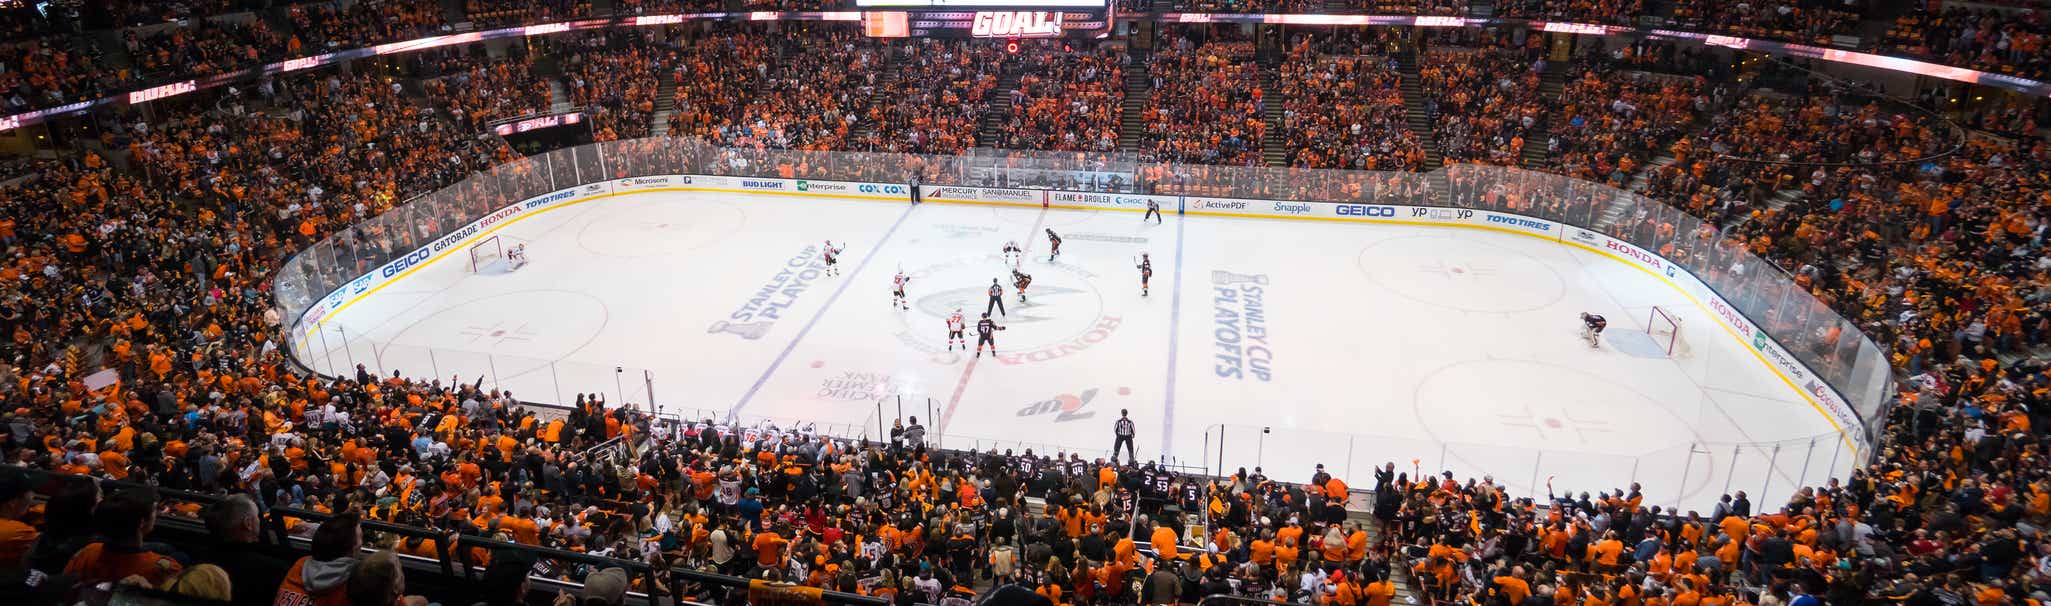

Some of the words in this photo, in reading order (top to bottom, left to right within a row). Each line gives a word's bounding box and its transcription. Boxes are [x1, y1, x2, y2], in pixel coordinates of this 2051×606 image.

[970, 11, 1064, 38] GOAL!
[743, 180, 760, 188] BUD
[760, 181, 783, 190] LIGHT
[942, 187, 977, 195] MERCURY
[525, 197, 549, 210] TOYO
[549, 190, 575, 203] TIRES
[1055, 193, 1077, 202] FLAME
[1206, 201, 1246, 210] ActivePDF
[1274, 202, 1311, 214] Snapple
[1336, 204, 1396, 218] GEICO
[1412, 207, 1428, 217] yp
[1457, 209, 1473, 219] yp
[480, 205, 522, 229] HONDA
[1487, 214, 1518, 225] TOYO
[1518, 218, 1550, 231] TIRES
[434, 224, 478, 253] GATORADE
[382, 247, 430, 279] GEICO
[1606, 239, 1662, 270] HONDA
[731, 268, 794, 323] STANLEY
[788, 245, 816, 267] CUP
[1240, 284, 1267, 344] STANLEY
[1710, 297, 1751, 337] HONDA
[1214, 287, 1244, 380] PLAYOFFS
[1247, 345, 1272, 381] CUP
[1020, 461, 1031, 473] 50
[1157, 481, 1168, 492] 53
[1189, 489, 1195, 501] 5
